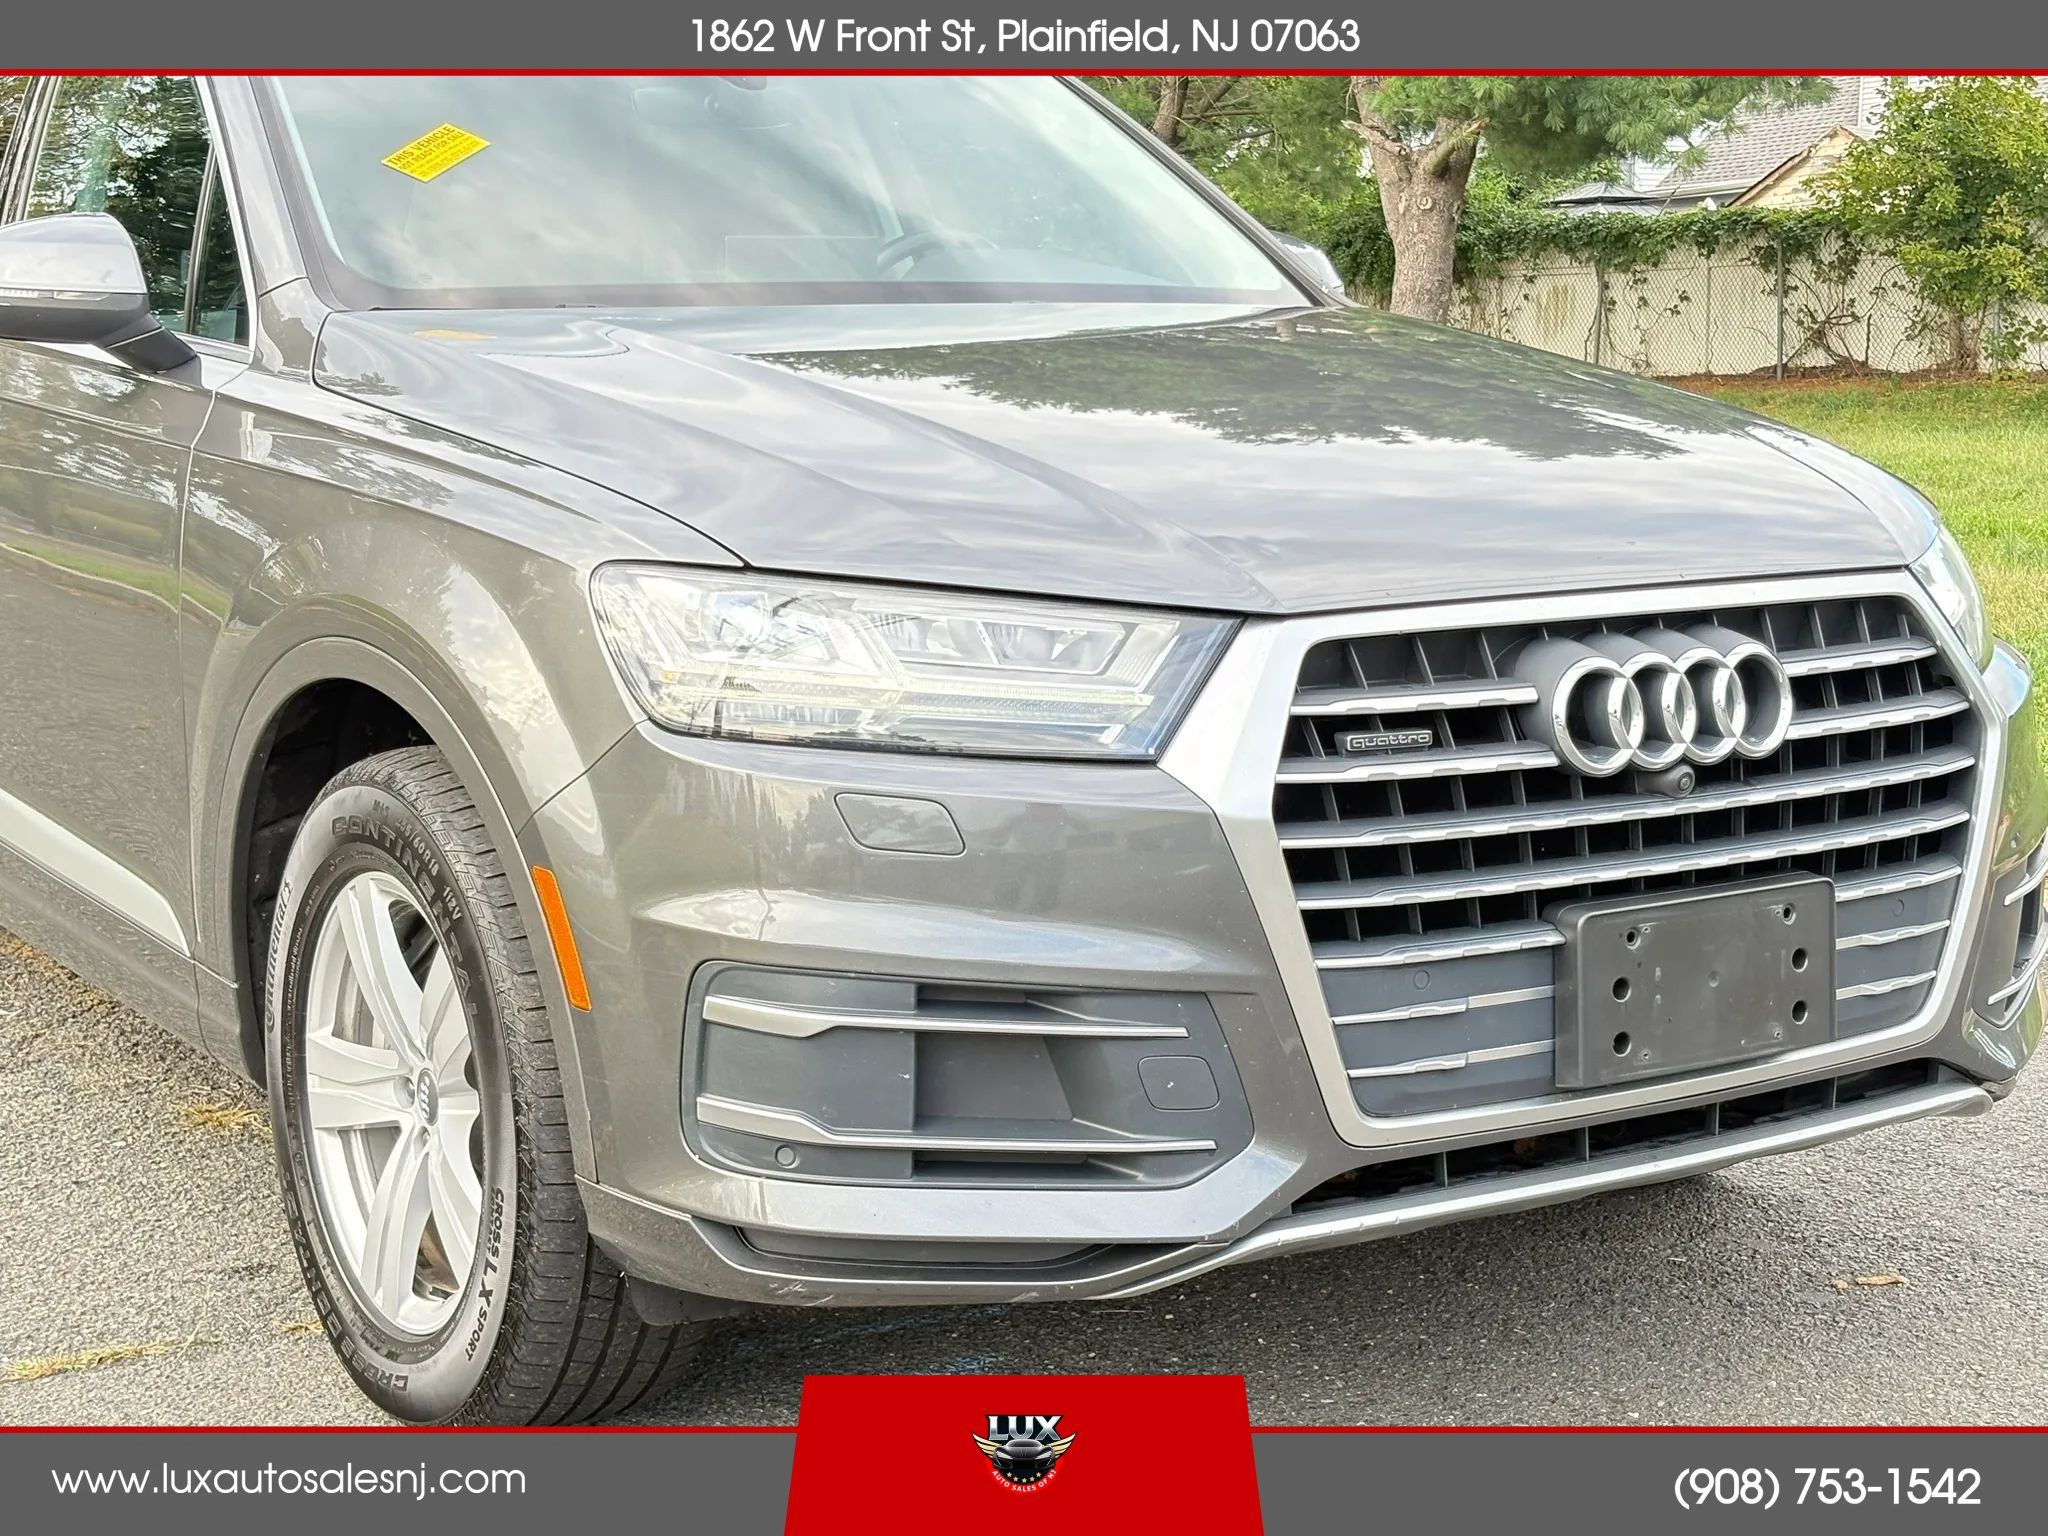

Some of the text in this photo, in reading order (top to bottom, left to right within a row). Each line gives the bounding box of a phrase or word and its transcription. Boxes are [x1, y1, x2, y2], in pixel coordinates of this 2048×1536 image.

[386, 149, 415, 166] THIS
[411, 126, 456, 150] VEHICLE
[1352, 734, 1430, 749] quattro
[331, 814, 479, 1032] CONTINENTAL
[443, 885, 463, 920] 112V
[264, 888, 290, 1034] Continental
[490, 1187, 504, 1259] CROSS
[464, 1305, 487, 1361] SPORT
